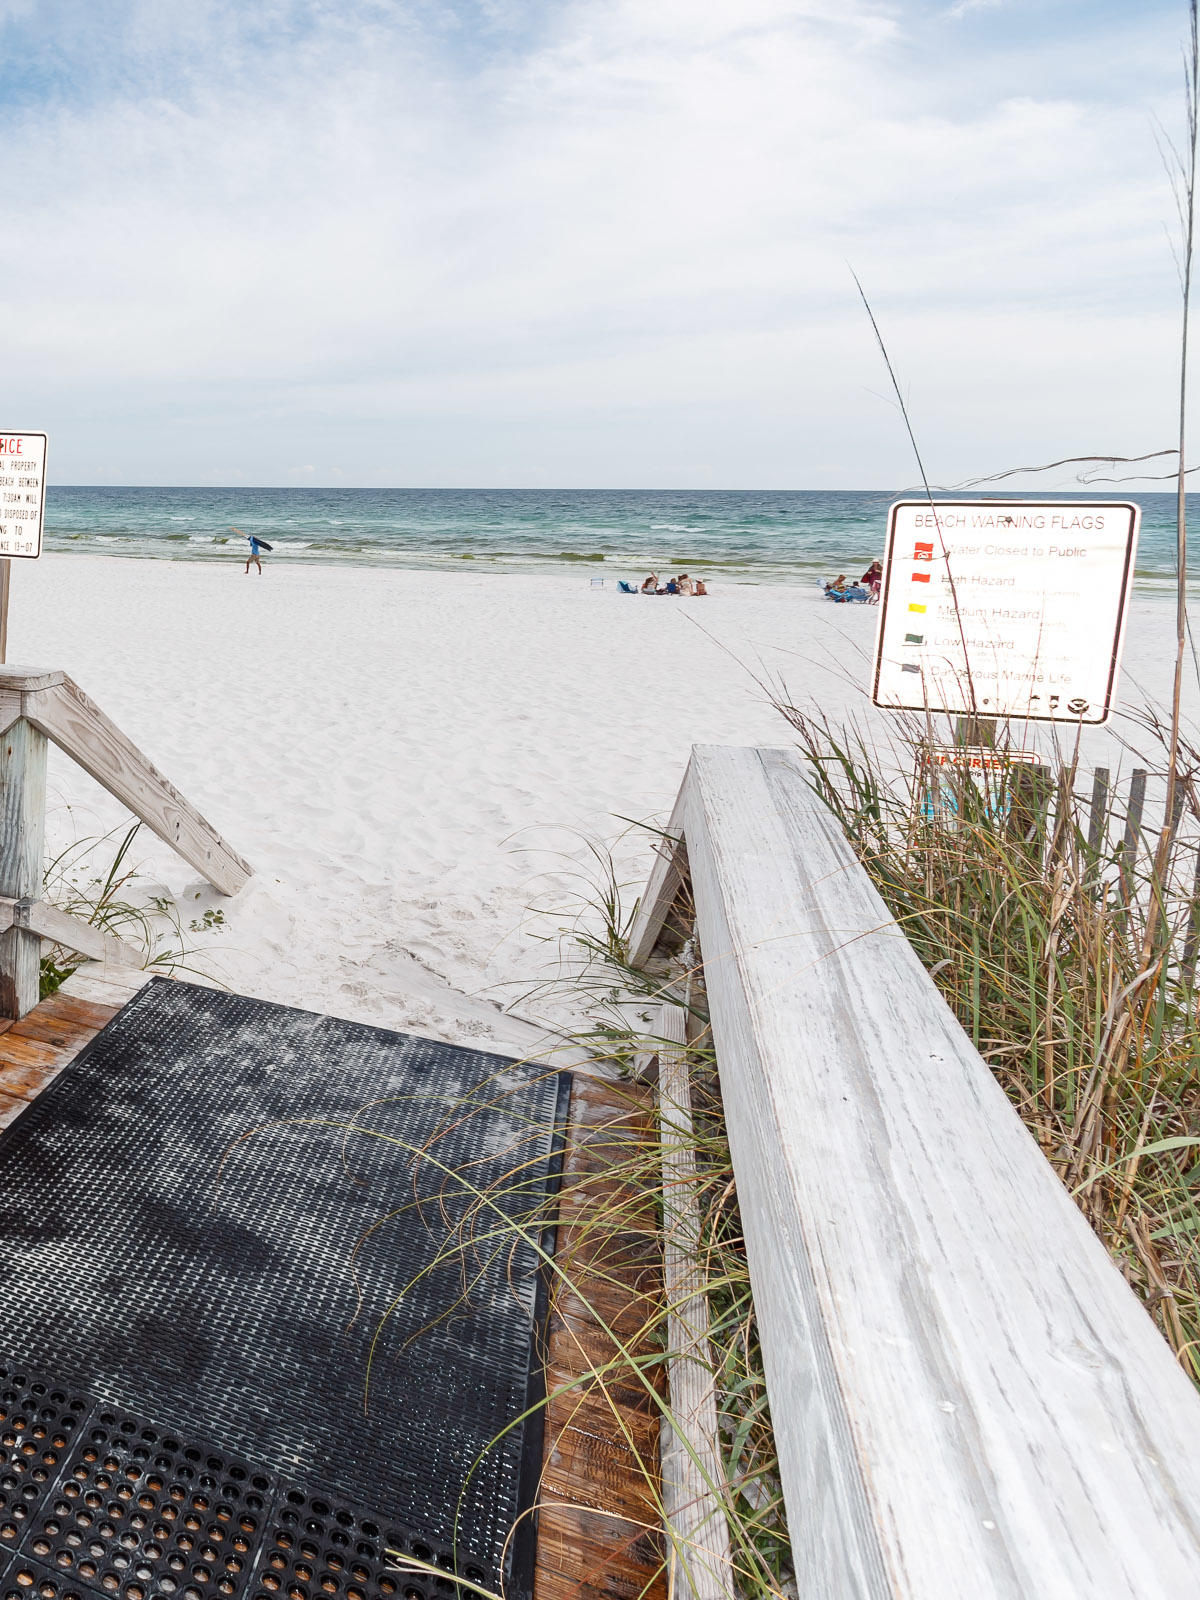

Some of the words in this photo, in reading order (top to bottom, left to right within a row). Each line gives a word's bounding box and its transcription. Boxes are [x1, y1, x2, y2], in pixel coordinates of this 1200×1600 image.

[10, 460, 37, 472] PROPERTY
[0, 476, 14, 487] BEACH
[18, 477, 39, 488] BETWEEN
[25, 493, 37, 505] WILL
[4, 509, 29, 520] DISPOSED
[30, 510, 38, 520] OF
[914, 513, 966, 529] BEACH
[971, 514, 1046, 530] WARNING
[1051, 514, 1106, 530] FLAGS
[14, 525, 23, 536] TO
[984, 544, 1029, 557] Closed
[1032, 545, 1044, 557] to
[1047, 545, 1088, 558] Public
[971, 574, 1016, 587] Hazard
[992, 606, 1040, 620] Hazard
[966, 637, 1015, 650] Hazard
